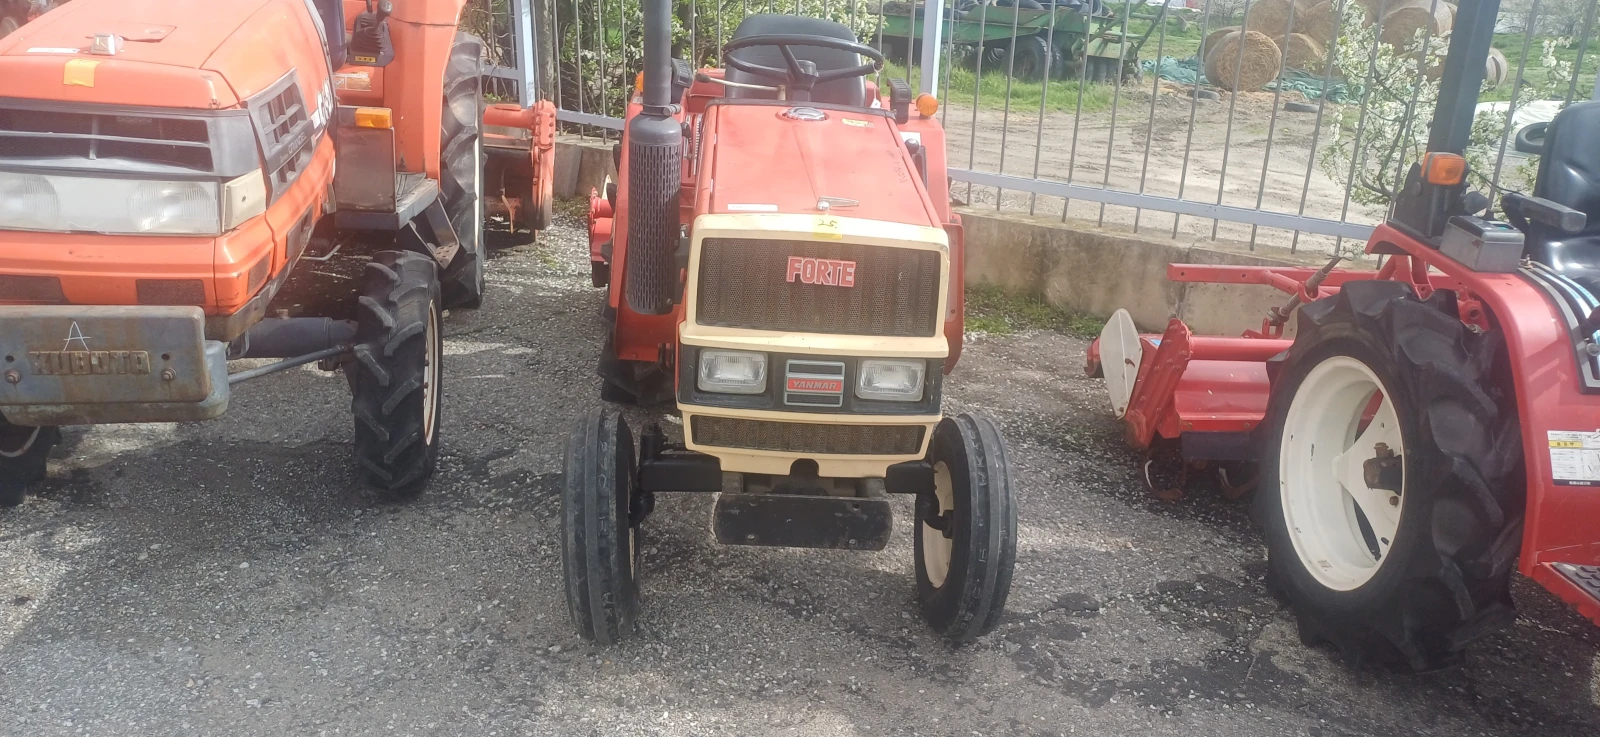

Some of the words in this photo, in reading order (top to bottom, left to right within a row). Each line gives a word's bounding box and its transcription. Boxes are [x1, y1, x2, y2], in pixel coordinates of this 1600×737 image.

[786, 256, 857, 288] FORTE
[28, 350, 151, 376] KUBOTA
[792, 380, 837, 390] YANMAR
